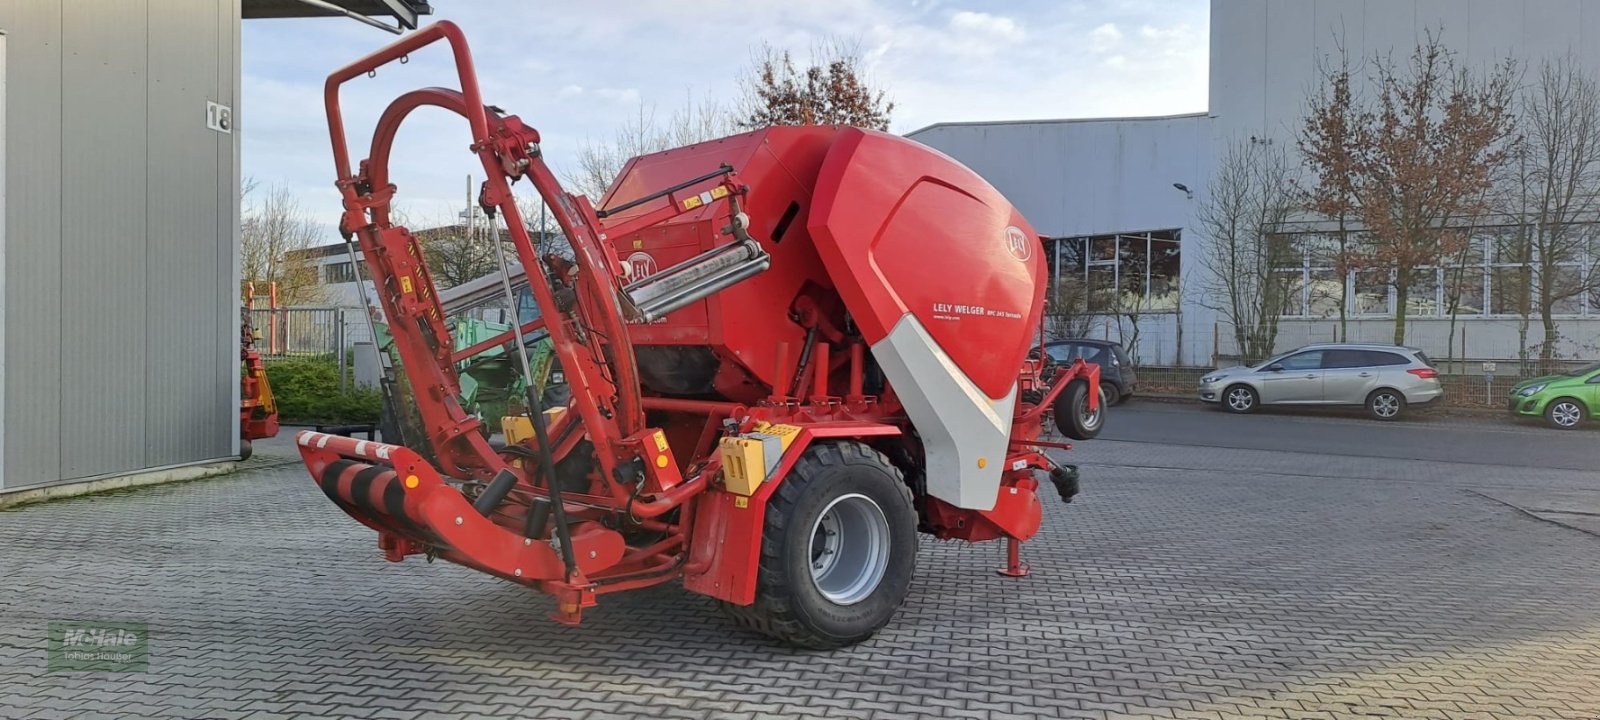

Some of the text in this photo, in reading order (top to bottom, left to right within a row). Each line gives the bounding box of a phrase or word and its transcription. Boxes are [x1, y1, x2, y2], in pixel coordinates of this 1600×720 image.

[210, 105, 231, 131] 18
[933, 303, 953, 312] LELY
[954, 305, 985, 315] WELGER
